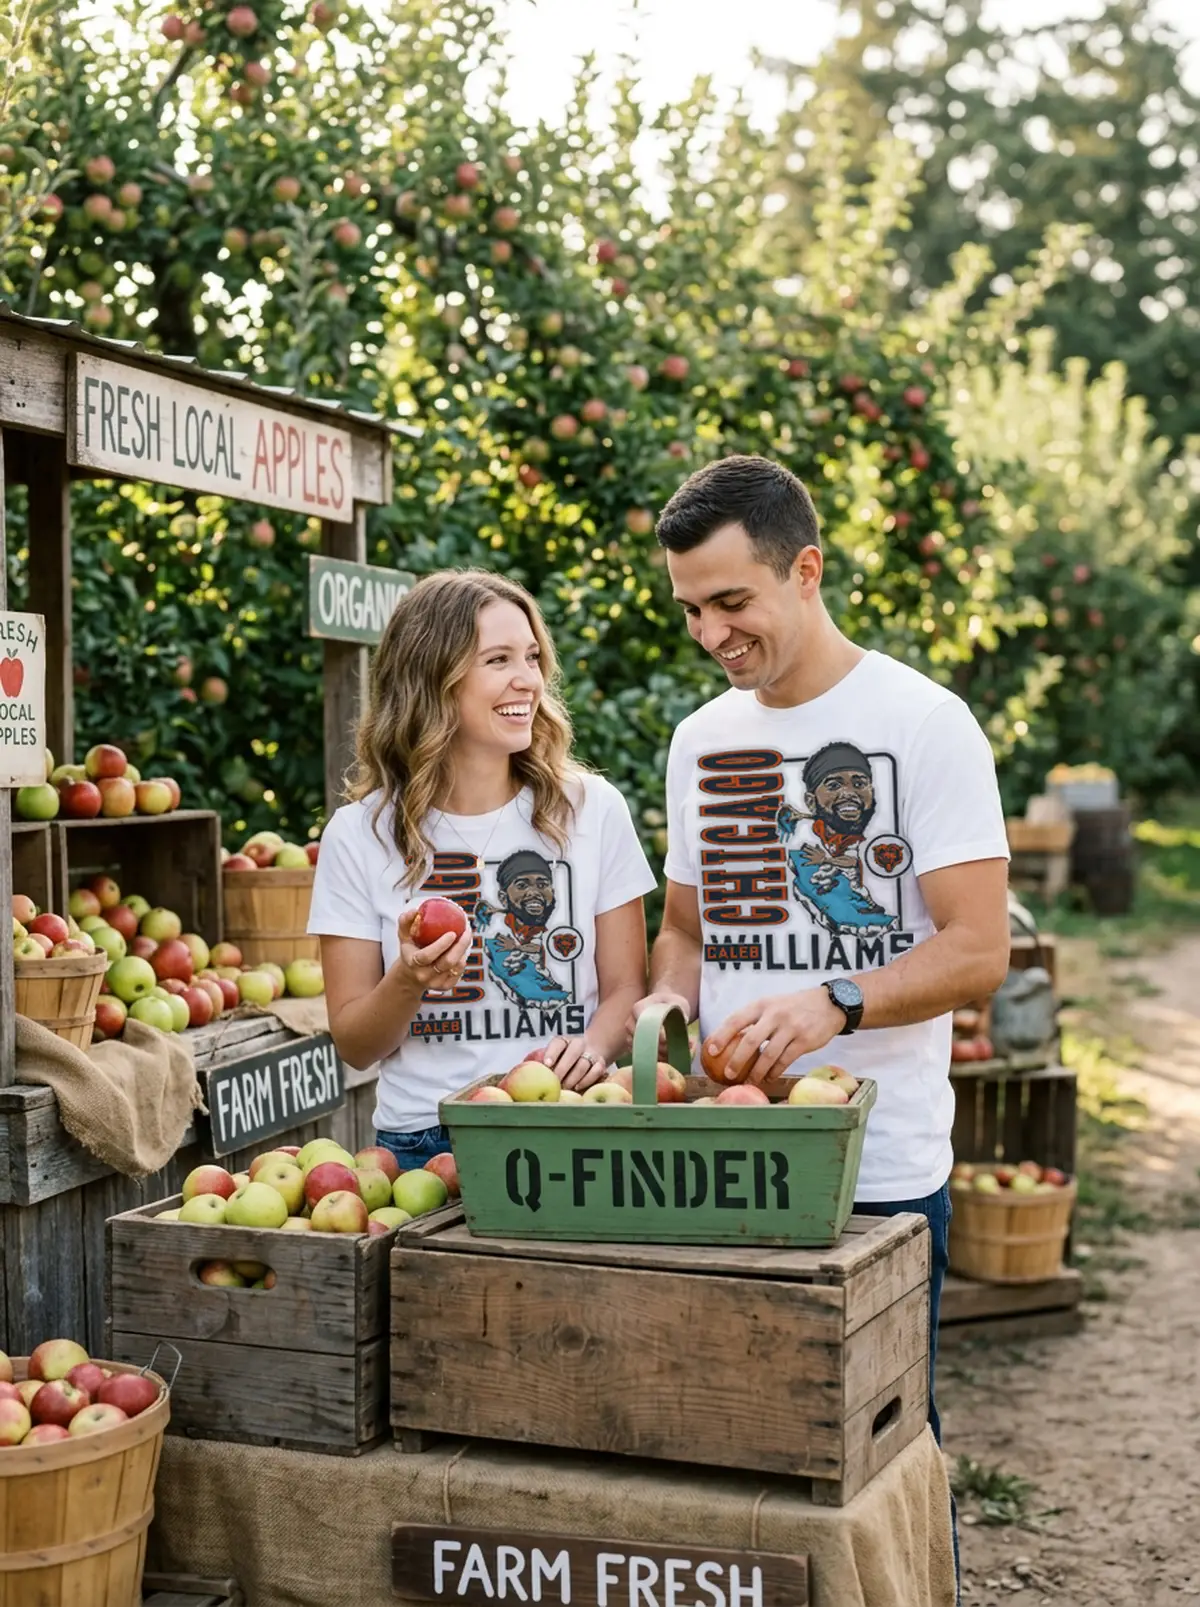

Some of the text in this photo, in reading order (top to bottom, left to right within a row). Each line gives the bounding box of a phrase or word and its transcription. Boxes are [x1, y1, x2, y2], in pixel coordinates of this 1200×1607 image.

[84, 377, 344, 510] FRESH LOCAL APPLES
[0, 620, 38, 653] RESH
[0, 703, 35, 721] OCAL
[698, 749, 789, 926] CHICAGO
[706, 945, 759, 959] CALEB
[412, 1020, 460, 1035] CALEB
[216, 1043, 339, 1142] FARM FRESH
[505, 1148, 790, 1213] Q-FINDER
[433, 1540, 763, 1607] FARM FRESH
